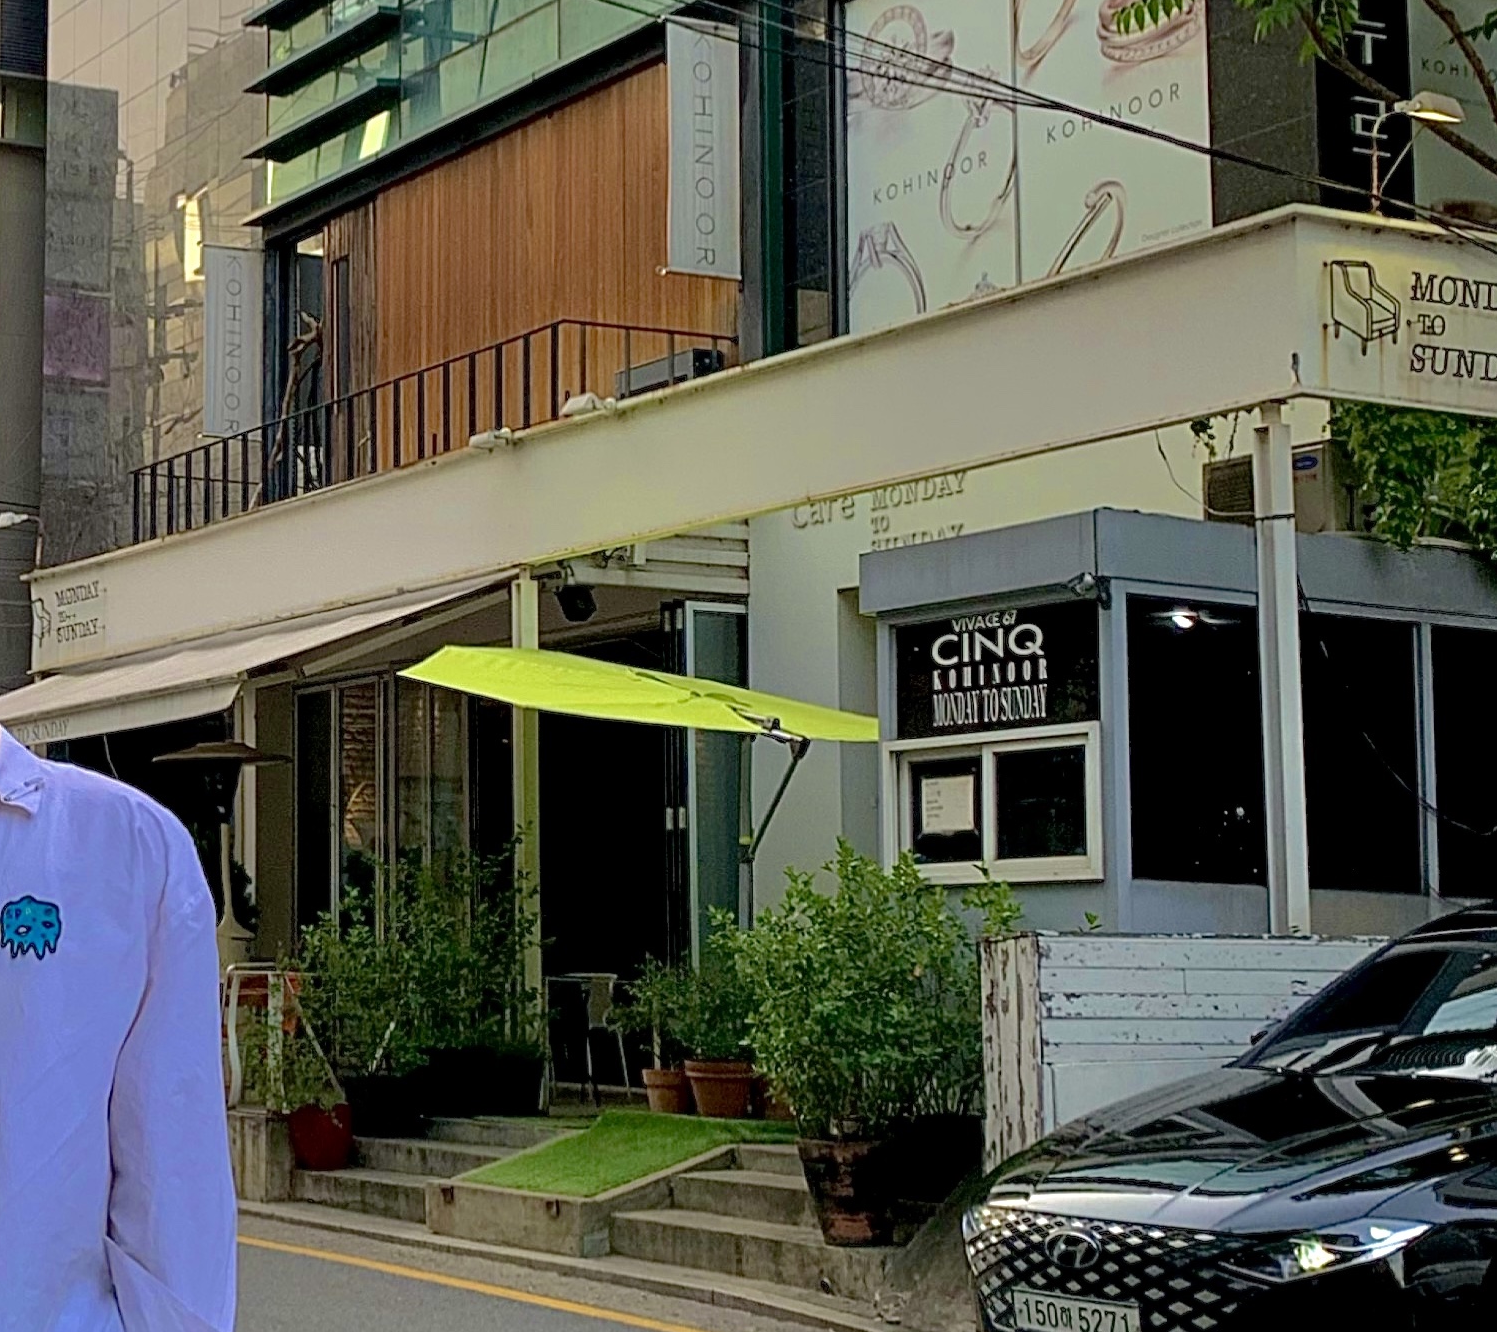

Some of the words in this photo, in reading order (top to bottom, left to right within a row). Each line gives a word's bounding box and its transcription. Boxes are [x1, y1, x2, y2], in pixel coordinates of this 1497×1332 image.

[1046, 82, 1181, 144] KOHNOOR
[693, 33, 715, 265] KOHINOOR
[224, 254, 242, 433] KOHINOOR
[1417, 313, 1446, 337] TO
[870, 470, 968, 511] MONDAY
[55, 580, 100, 607] MONDAY
[56, 618, 99, 643] SUNDAY
[952, 612, 1000, 633] VIVACE
[1003, 610, 1018, 625] 67
[931, 623, 1045, 666] CINQ
[932, 658, 1048, 691] KOHINOOR
[933, 690, 980, 727] MONDAY
[982, 688, 999, 723] TO
[1001, 683, 1048, 722] SUNDAY
